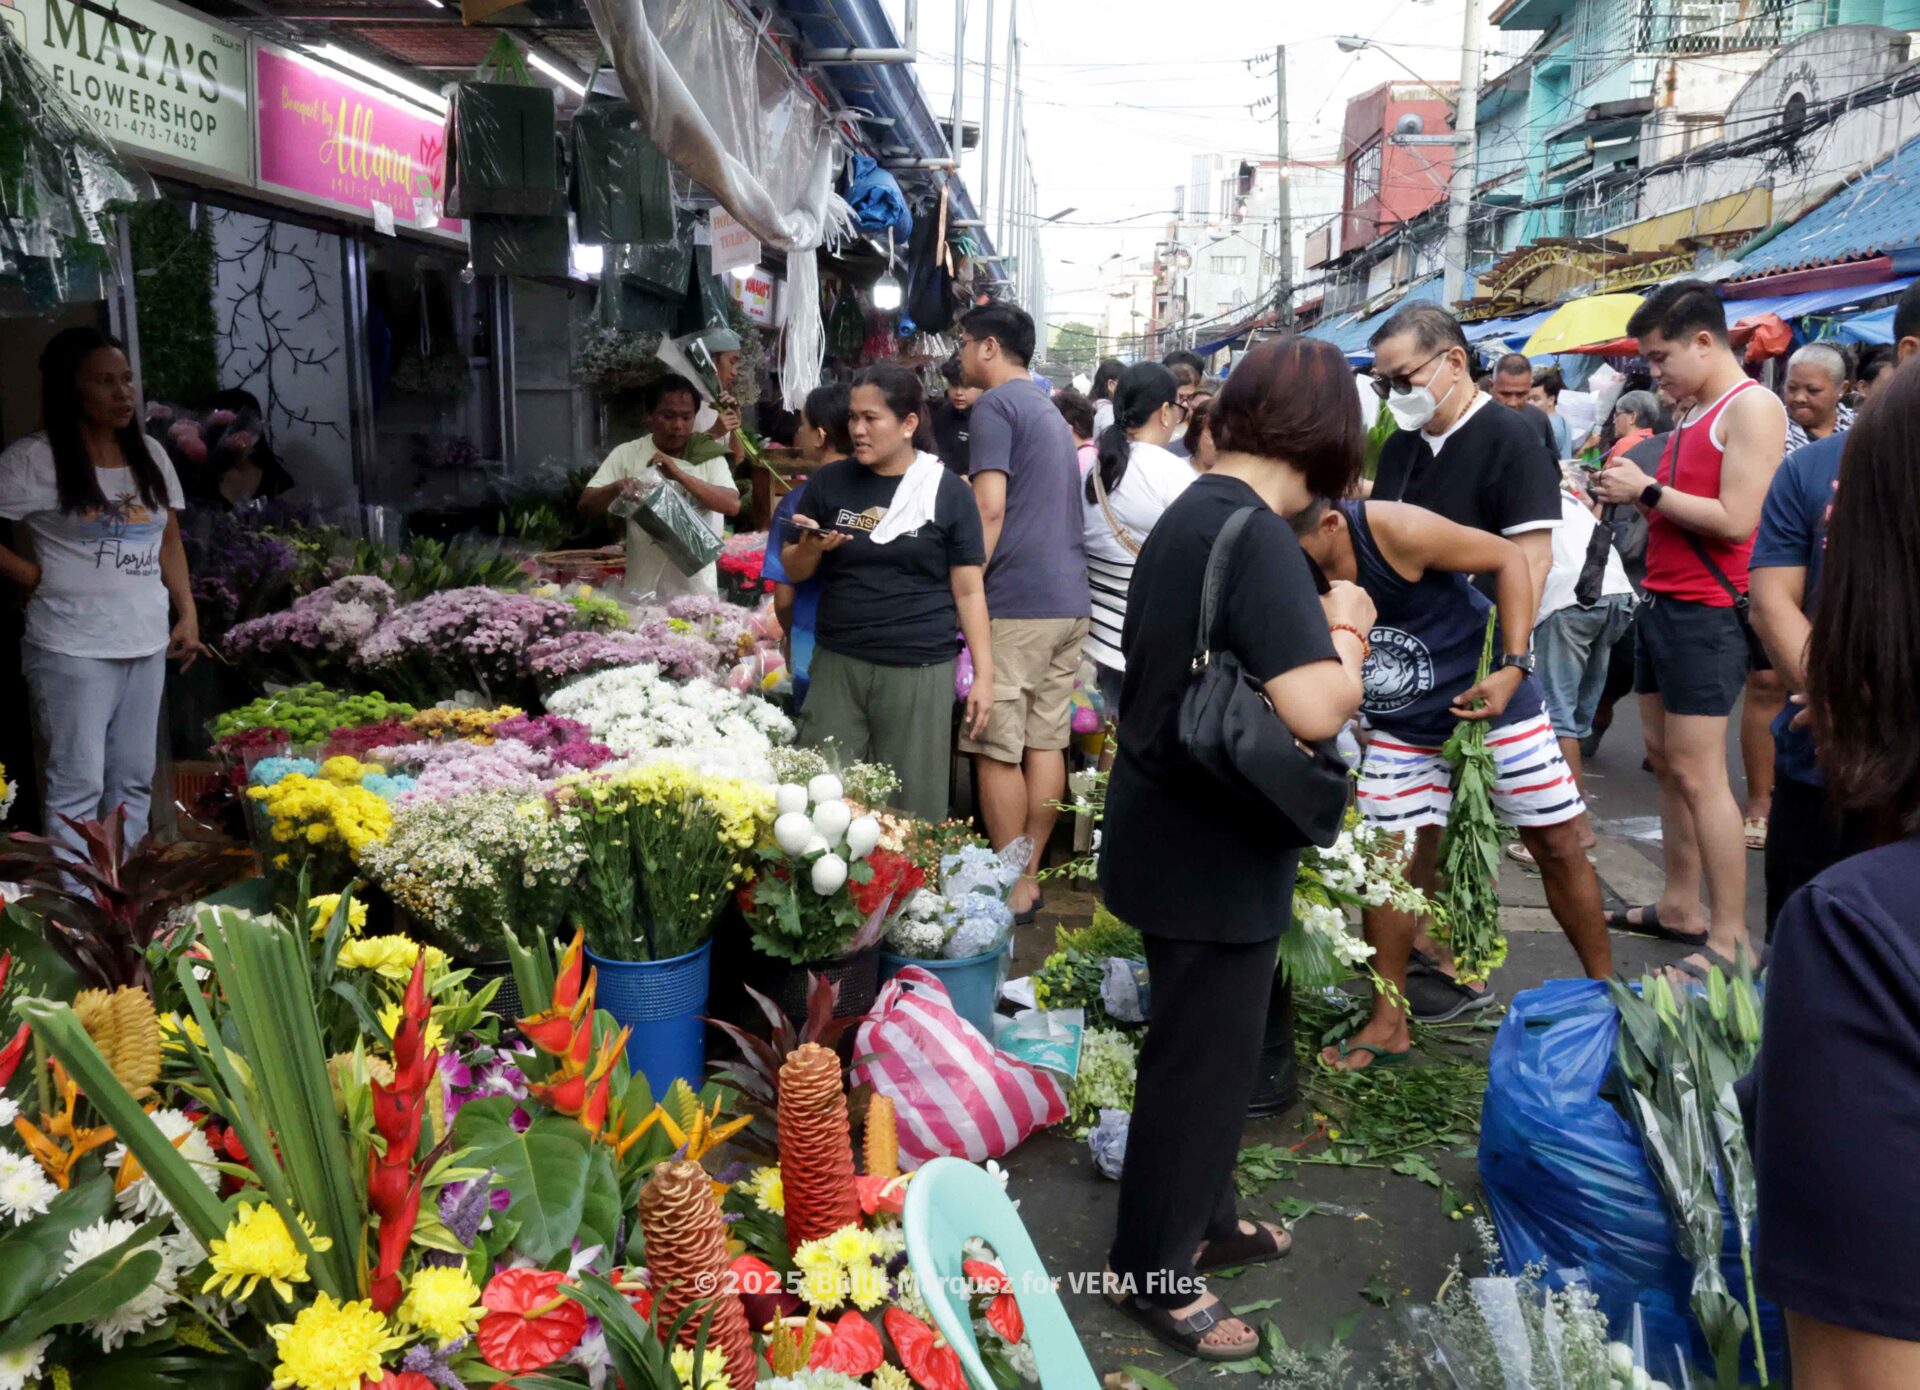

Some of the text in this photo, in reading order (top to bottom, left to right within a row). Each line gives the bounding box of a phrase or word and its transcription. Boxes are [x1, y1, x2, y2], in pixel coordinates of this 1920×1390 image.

[43, 0, 219, 104] MAYA'S
[53, 64, 217, 136] FLOWERSHOP
[320, 97, 412, 195] Allana
